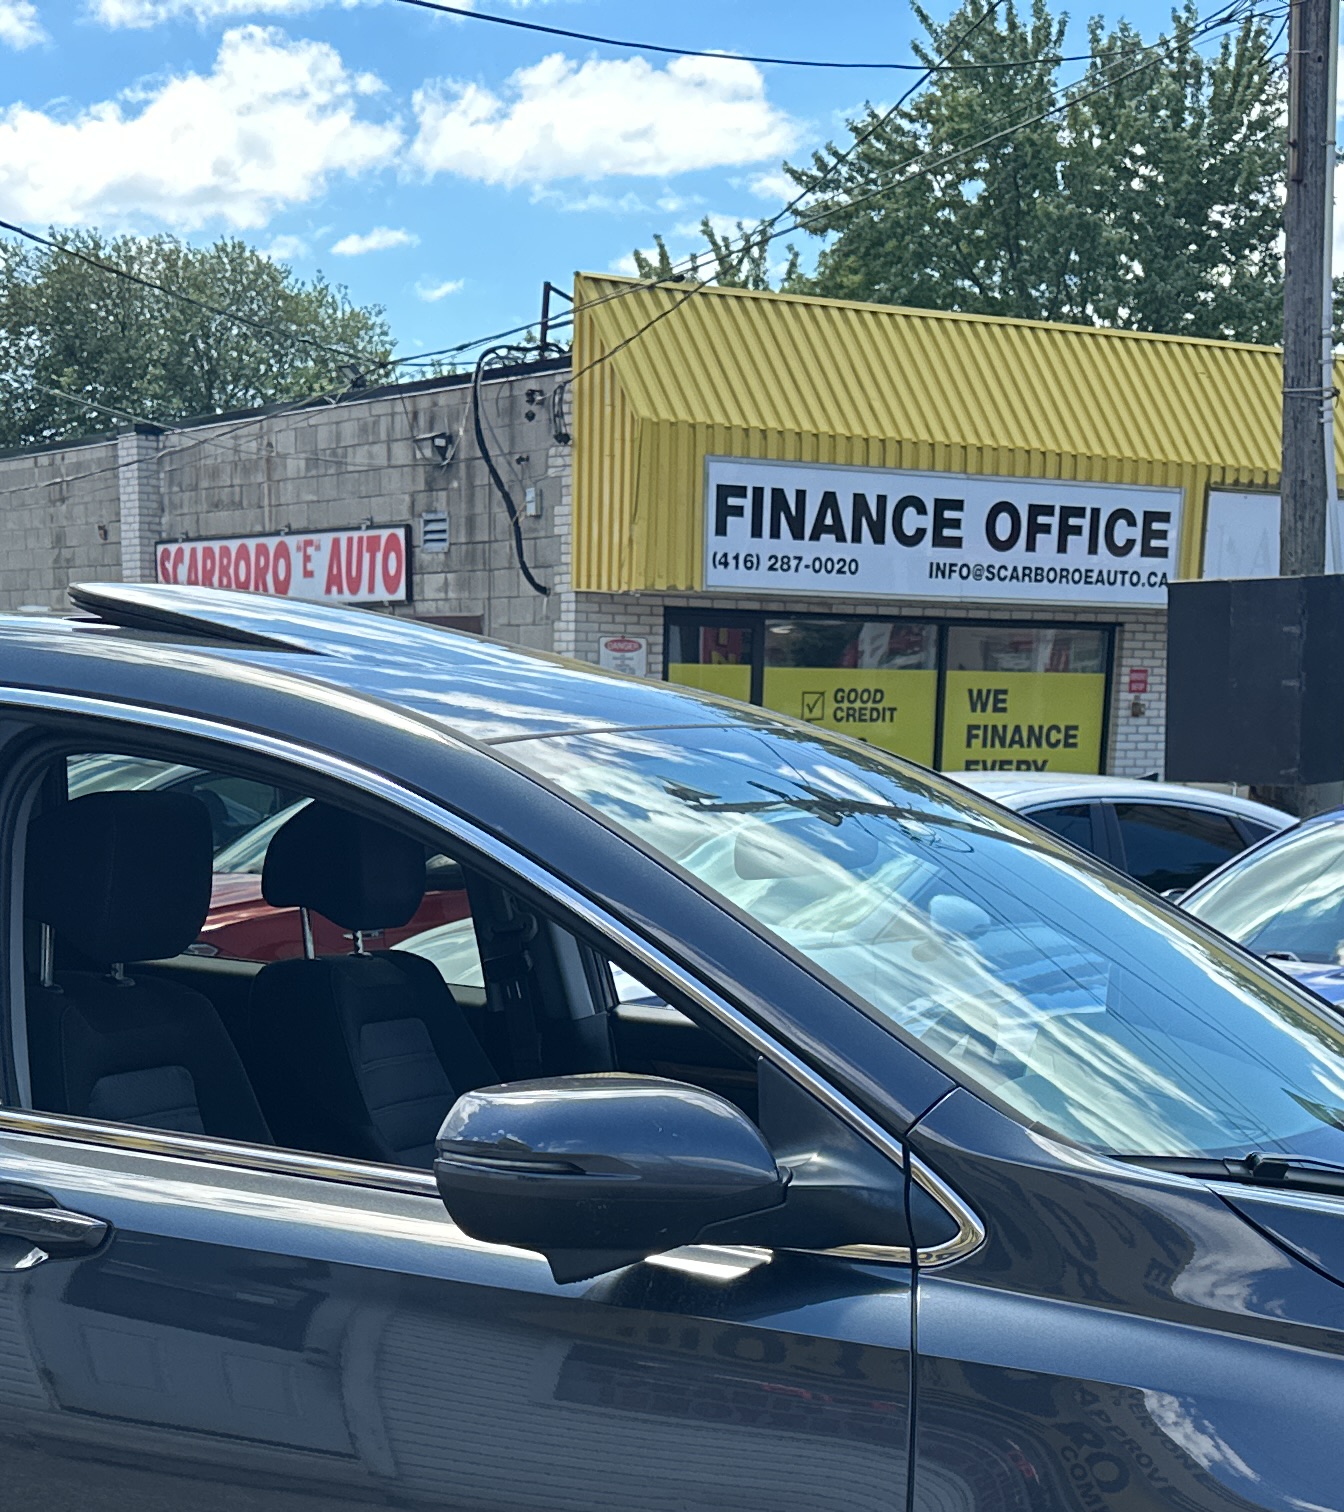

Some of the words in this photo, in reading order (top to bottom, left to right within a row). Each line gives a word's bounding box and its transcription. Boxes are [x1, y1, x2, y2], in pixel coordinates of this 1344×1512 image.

[714, 484, 965, 549] FINANCE
[985, 500, 1171, 559] OFFICE
[160, 540, 292, 596] SCARBORO
[324, 532, 403, 596] AUTO
[712, 551, 761, 572] (416)
[767, 555, 860, 576] 287-0020
[928, 561, 1169, 589] INFO@SCARBOROEAUTO.CA
[833, 687, 885, 704] GOOD
[967, 688, 1009, 713] WE
[832, 706, 897, 723] CREDIT
[965, 724, 1079, 749] FINANCE
